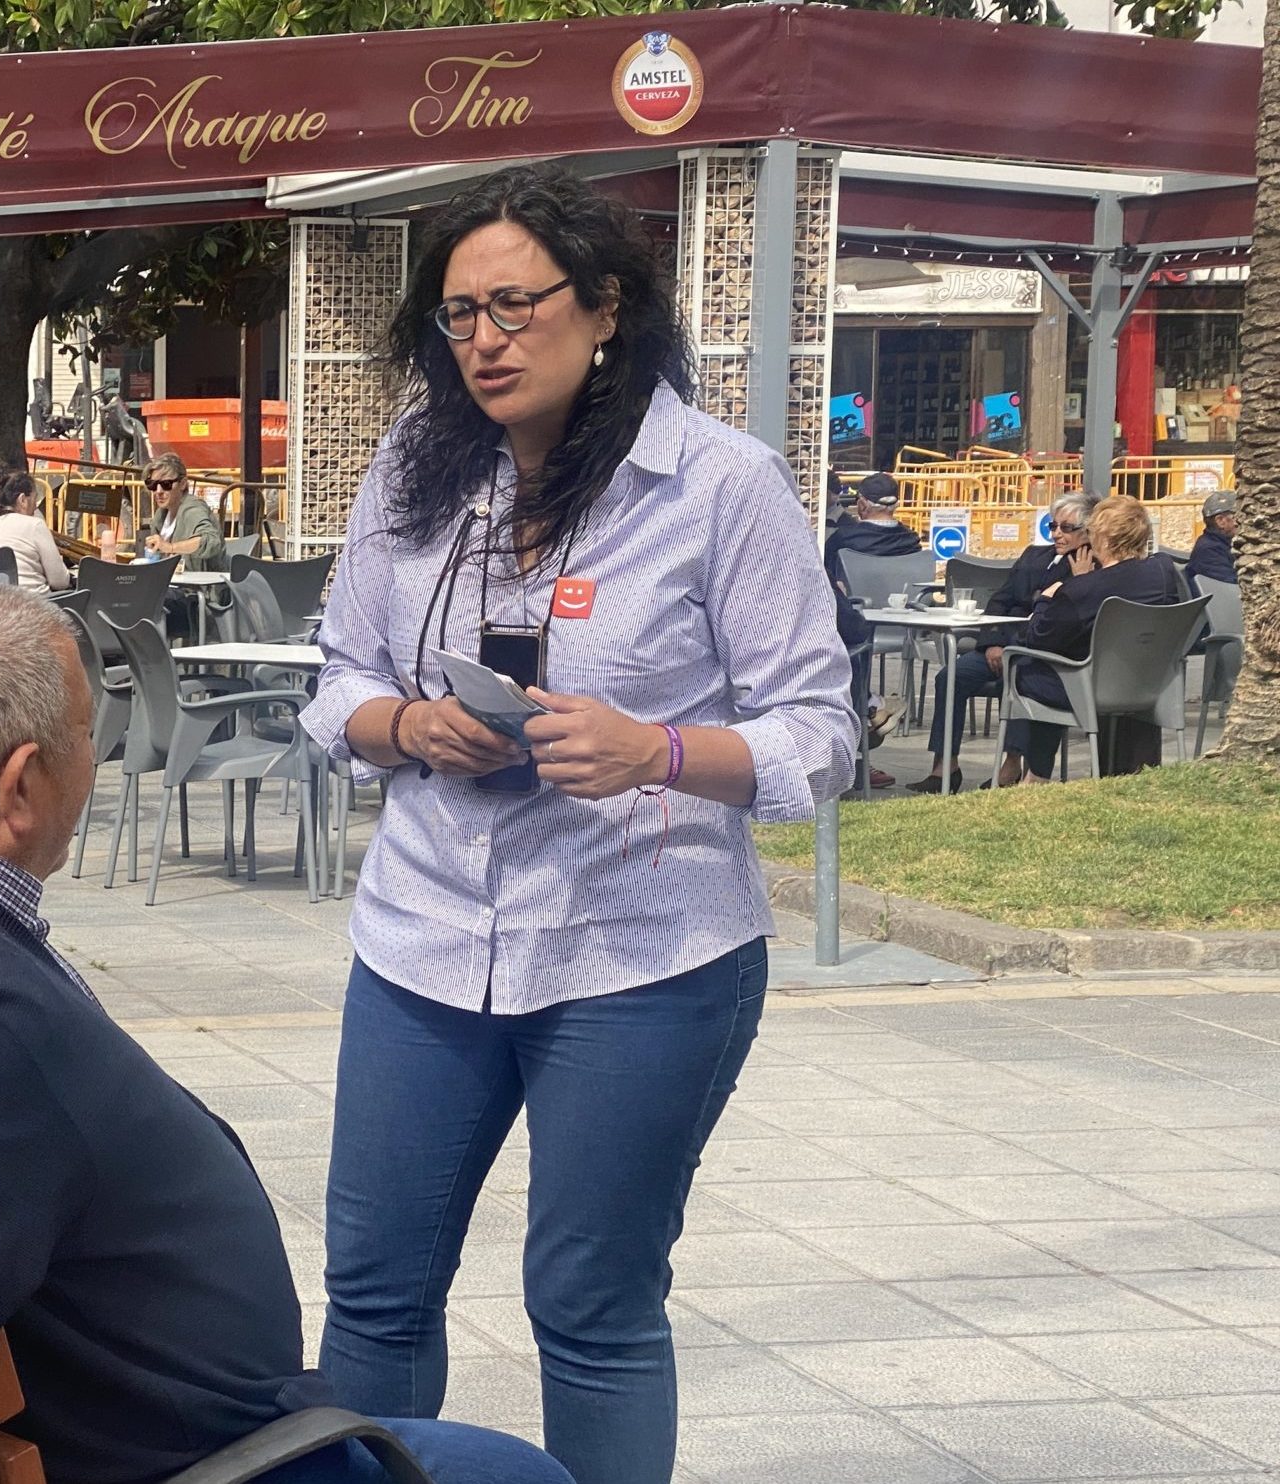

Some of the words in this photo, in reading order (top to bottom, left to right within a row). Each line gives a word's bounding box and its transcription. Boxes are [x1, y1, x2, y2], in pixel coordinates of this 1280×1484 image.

[630, 69, 686, 86] AMSTEL
[635, 90, 680, 100] CERVEZA
[84, 75, 328, 169] Araque
[409, 48, 543, 138] Tim
